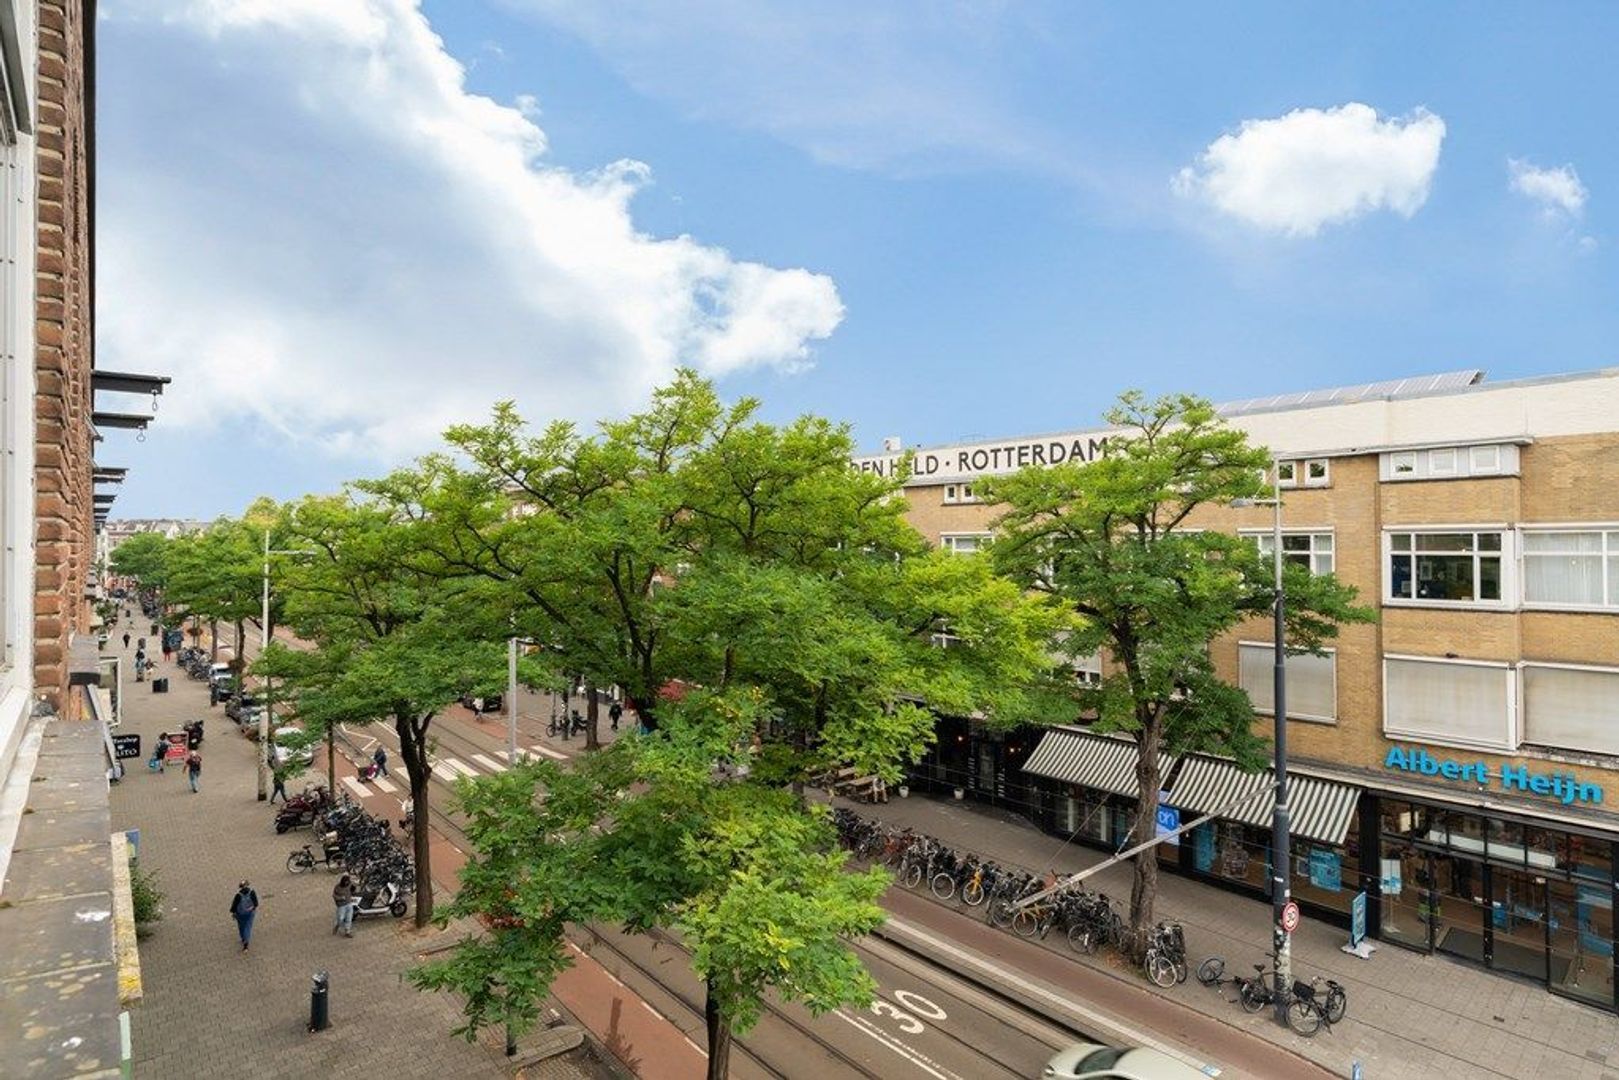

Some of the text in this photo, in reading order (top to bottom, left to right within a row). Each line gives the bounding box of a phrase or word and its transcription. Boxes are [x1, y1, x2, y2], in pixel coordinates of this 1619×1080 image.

[889, 455, 939, 477] HLD
[958, 437, 1108, 472] ROTTERDAM
[1385, 746, 1604, 805] Albert Heijn
[871, 989, 947, 1034] 30
